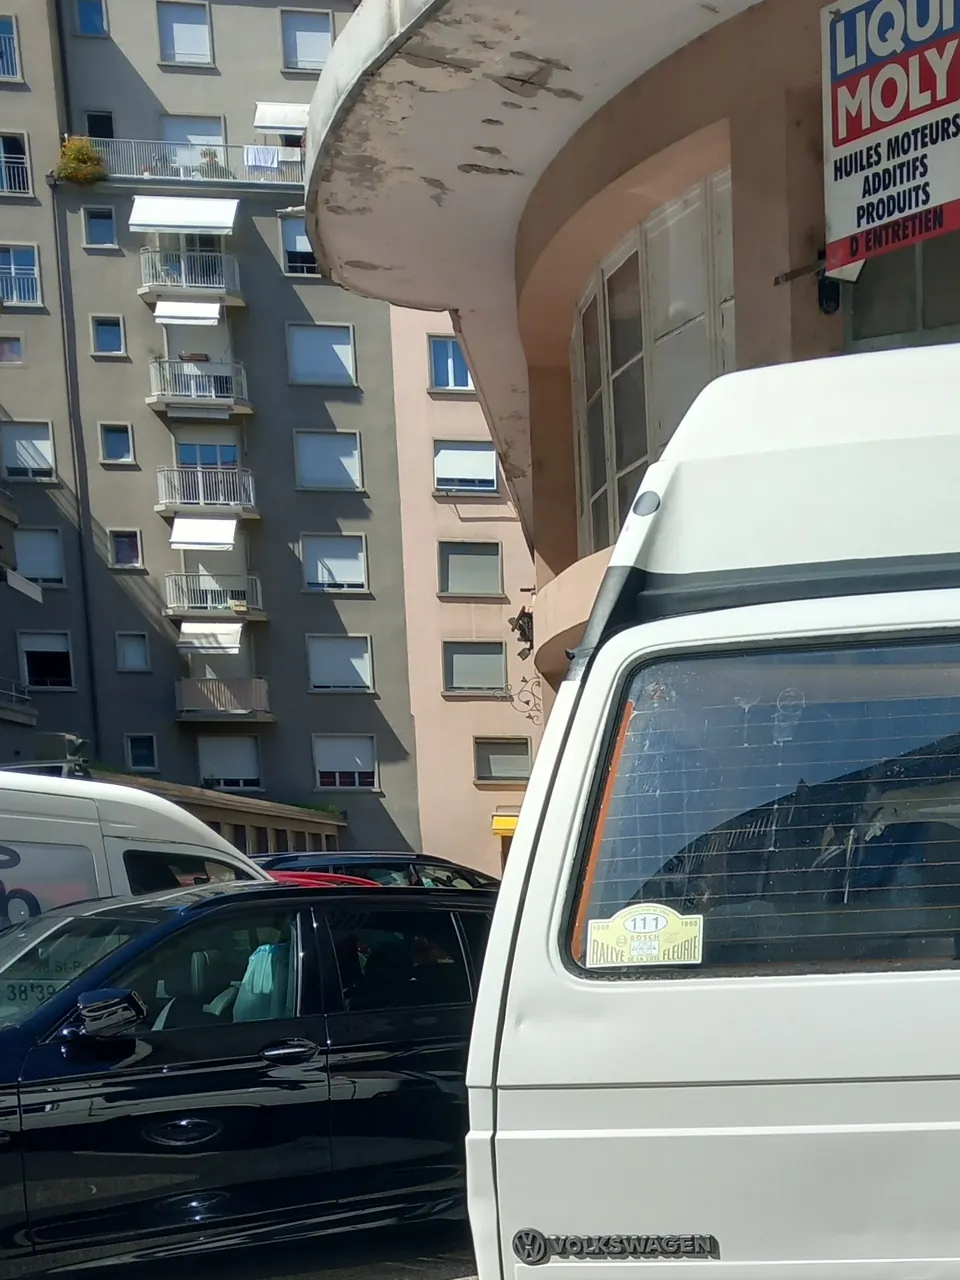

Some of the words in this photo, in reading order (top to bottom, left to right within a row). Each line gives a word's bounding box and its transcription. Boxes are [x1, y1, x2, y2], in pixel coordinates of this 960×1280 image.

[837, 38, 960, 140] MOLY
[833, 142, 882, 182] HUILES
[886, 112, 960, 161] MOTEURS
[861, 153, 928, 199] ADDITIFS
[856, 181, 930, 228] PRODUITS
[631, 916, 659, 930] 111
[592, 939, 625, 965] RALLYE
[662, 935, 698, 961] FLEURIE
[549, 1234, 717, 1257] VOLKSWAGEN
